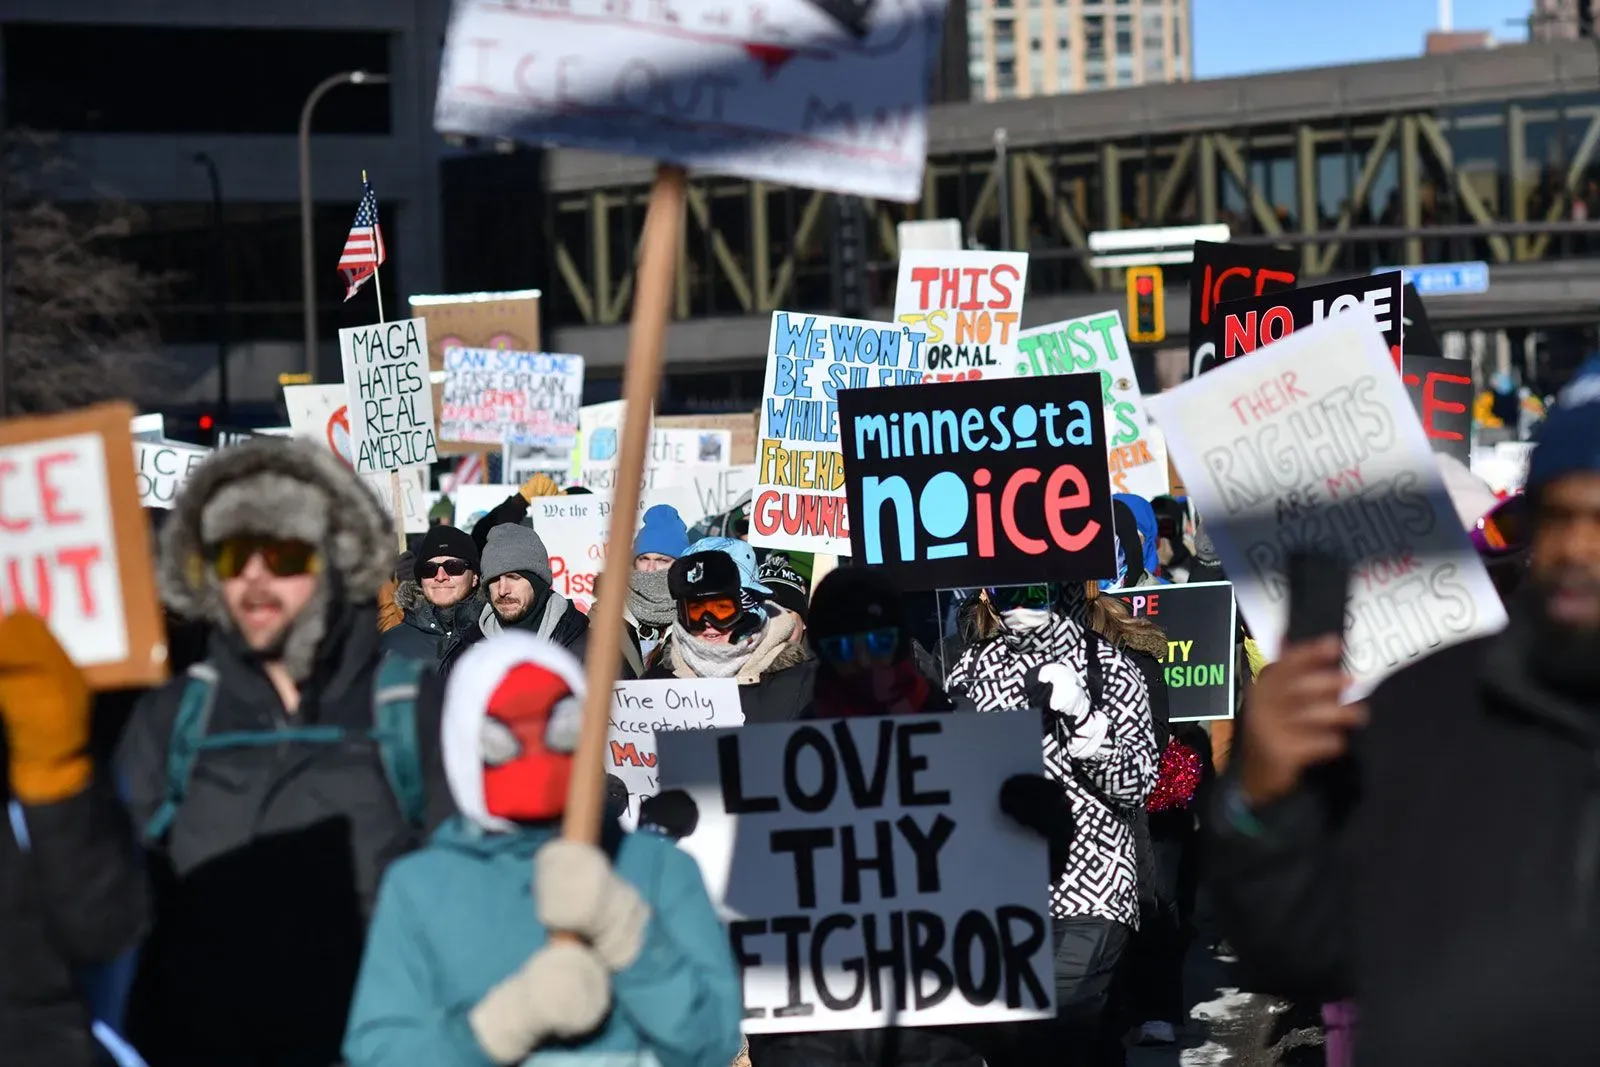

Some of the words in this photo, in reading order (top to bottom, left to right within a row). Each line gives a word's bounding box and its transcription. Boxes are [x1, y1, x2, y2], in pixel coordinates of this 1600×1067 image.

[911, 264, 1020, 310] THIS
[352, 321, 421, 364] MAGA
[775, 313, 827, 360] WE
[830, 324, 926, 370] WON'T
[955, 311, 1019, 345] NOT
[1017, 315, 1119, 377] TRUST
[1225, 305, 1294, 359] NO
[774, 356, 813, 398] BE
[924, 344, 1002, 370] ORMAL.
[358, 361, 423, 400] HATES
[1230, 370, 1309, 426] THEIR
[365, 395, 426, 436] REAL
[767, 398, 838, 442] WHILE
[1402, 371, 1472, 440] E
[357, 429, 437, 473] AMERICA
[854, 400, 1093, 460] minnesota
[1204, 375, 1396, 515] RIGHTS
[140, 449, 205, 478] ICE
[759, 438, 846, 491] FRIEND
[1323, 463, 1365, 501] MY
[135, 472, 180, 502] OU
[542, 504, 566, 518] We
[569, 503, 588, 517] the
[754, 490, 851, 539] GUNNE
[862, 463, 1101, 565] noice
[0, 546, 101, 622] UT
[1122, 594, 1159, 617] PE
[1341, 562, 1477, 676] GHTS
[1158, 640, 1193, 663] TY
[612, 687, 654, 710] The
[665, 688, 715, 721] Only
[717, 719, 952, 815] LOVE
[770, 812, 957, 910] THY
[728, 904, 1051, 1020] EIGHBOR
